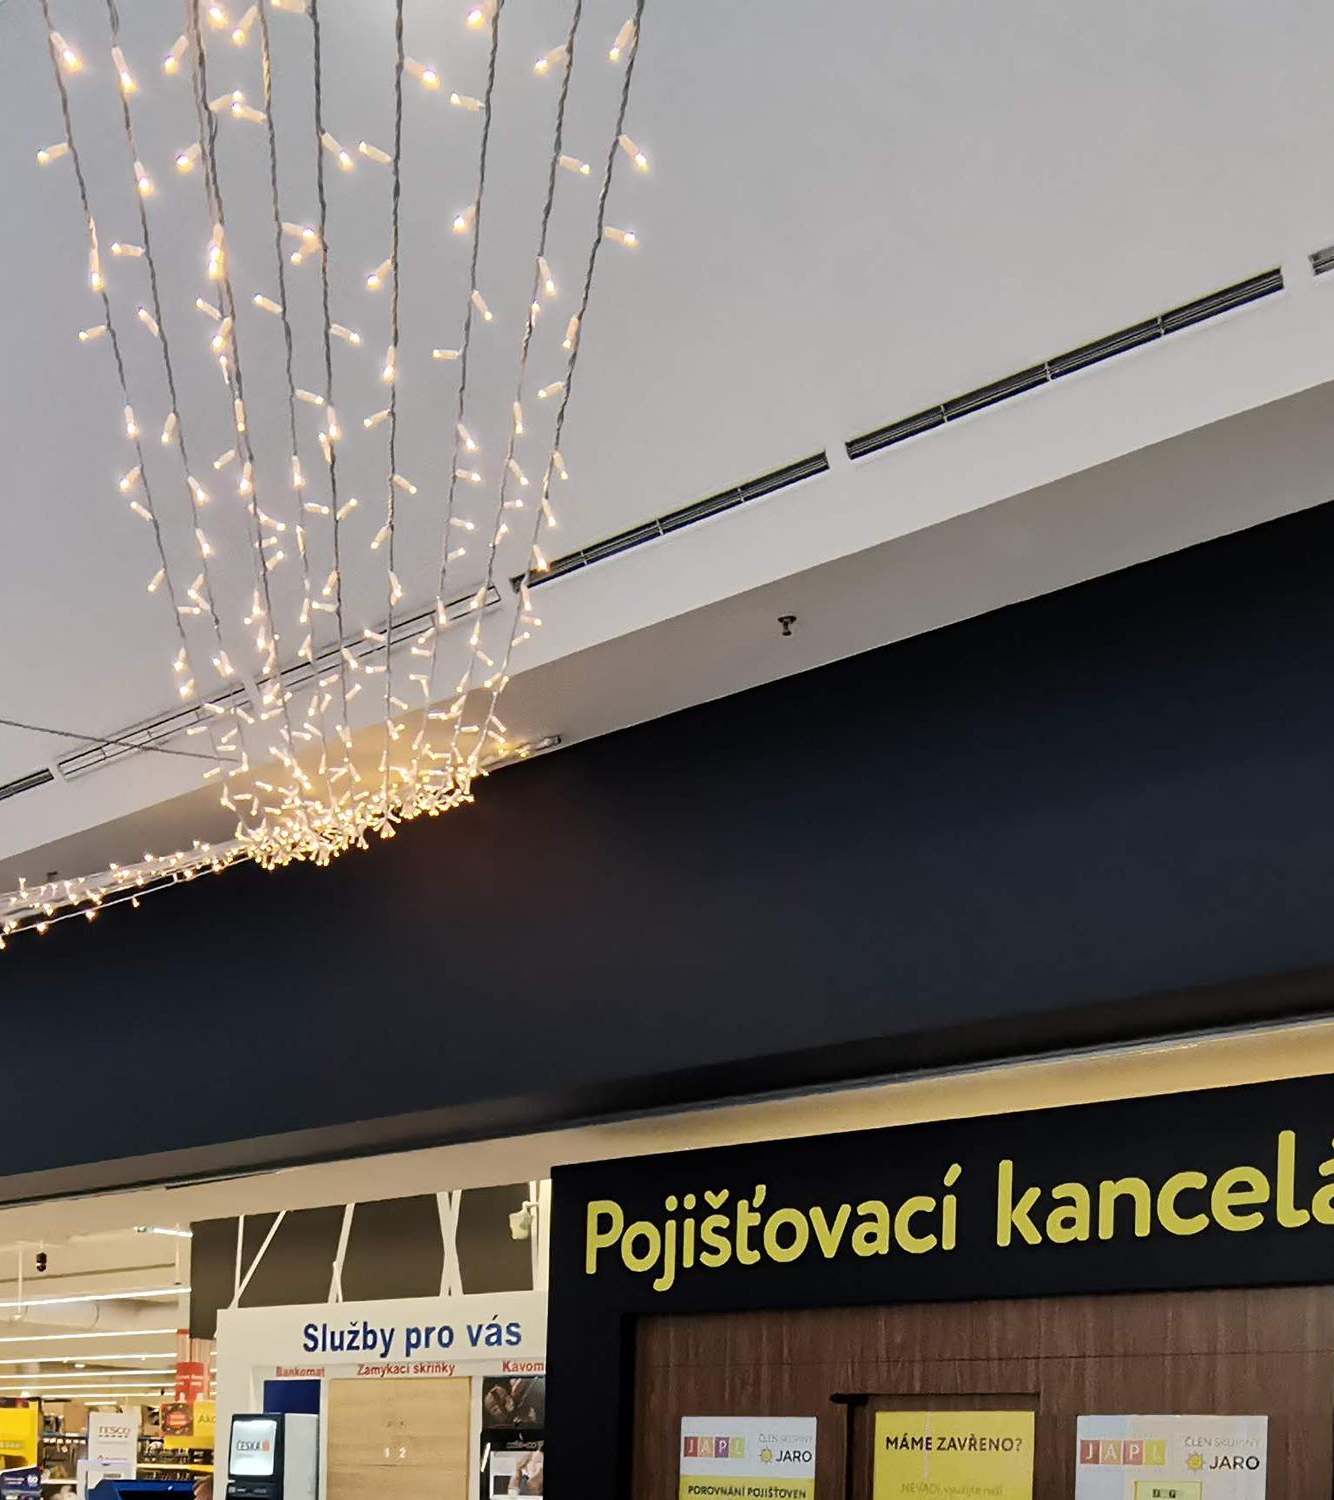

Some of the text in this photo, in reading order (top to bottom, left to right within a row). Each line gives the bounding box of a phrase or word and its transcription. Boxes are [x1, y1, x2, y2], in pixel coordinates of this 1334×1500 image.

[586, 1163, 962, 1291] Pojišťovací
[303, 1314, 522, 1358] Služby pro vás
[886, 1433, 1023, 1451] MÁME ZAVŘENO?
[776, 1450, 813, 1462] JARO
[1209, 1455, 1260, 1470] JARO
